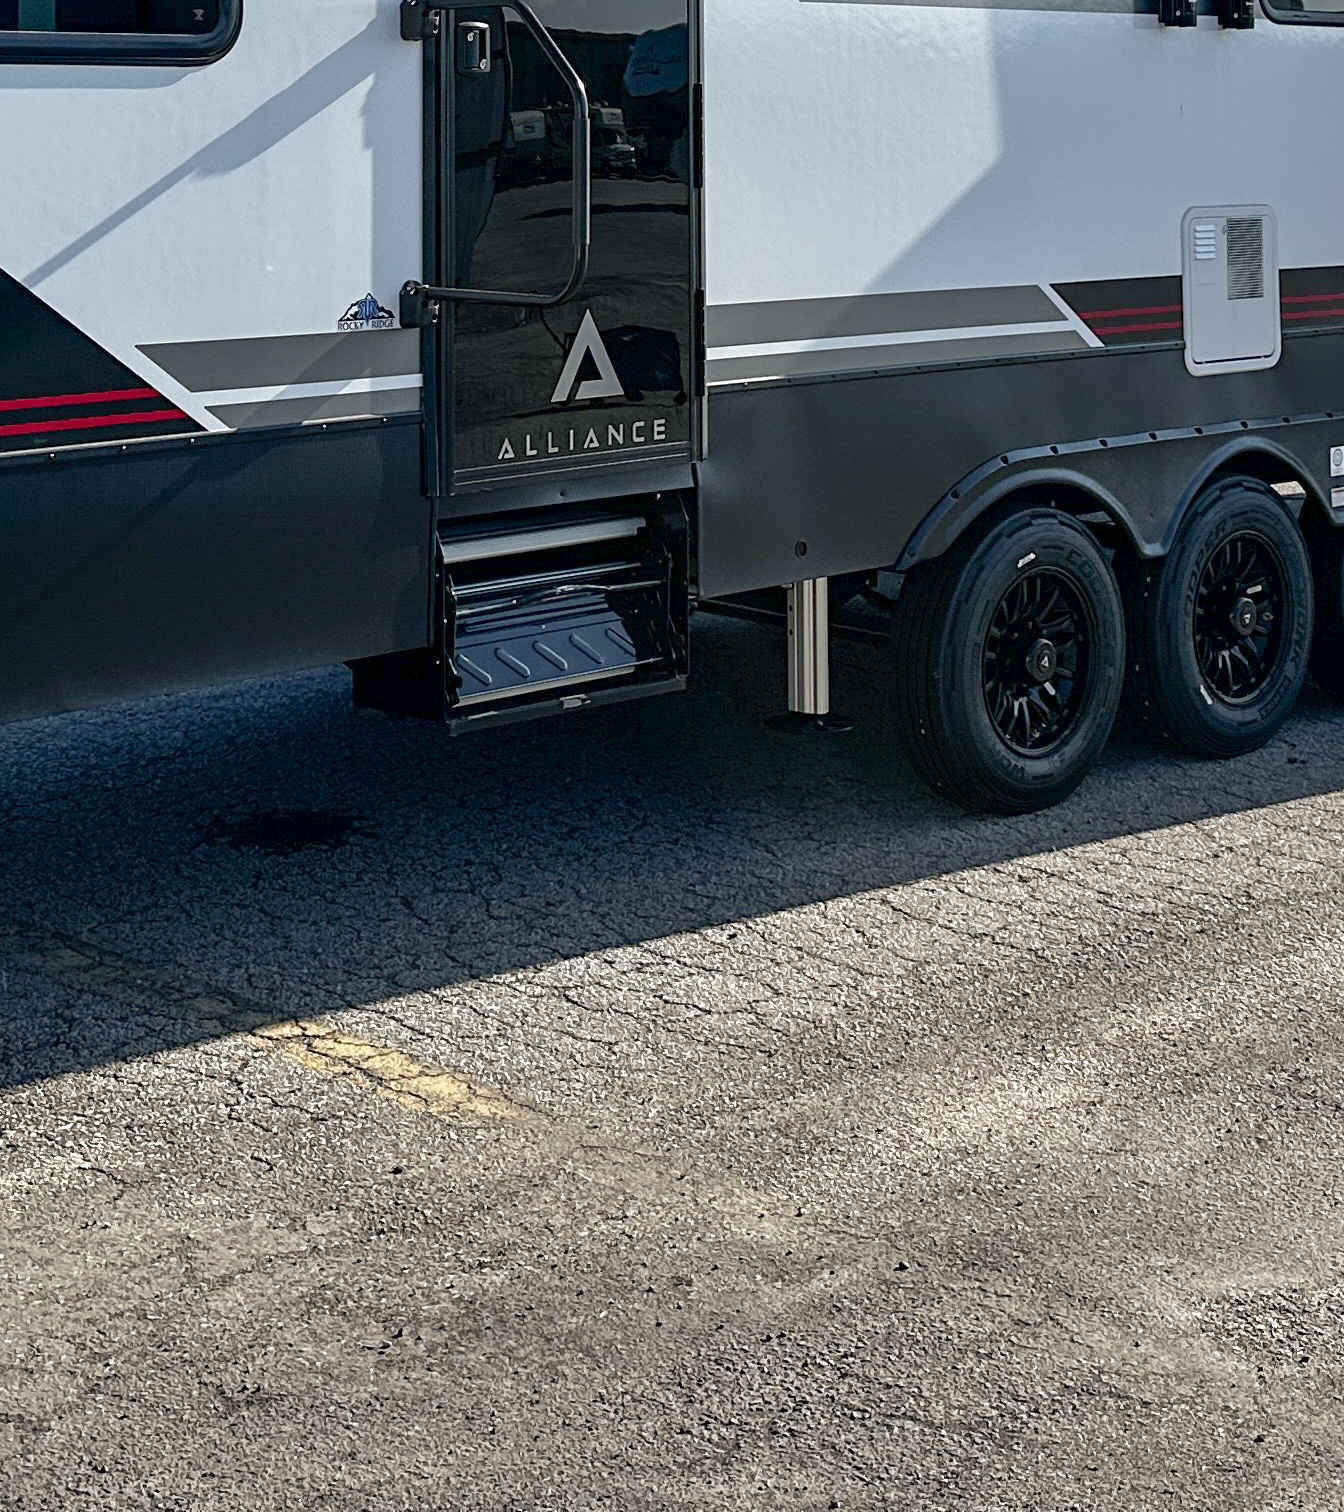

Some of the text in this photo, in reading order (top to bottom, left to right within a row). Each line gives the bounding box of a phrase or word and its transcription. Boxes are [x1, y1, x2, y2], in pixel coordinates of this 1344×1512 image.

[338, 319, 394, 331] ROCKY RIDGE
[498, 419, 666, 459] ALLIANCE
